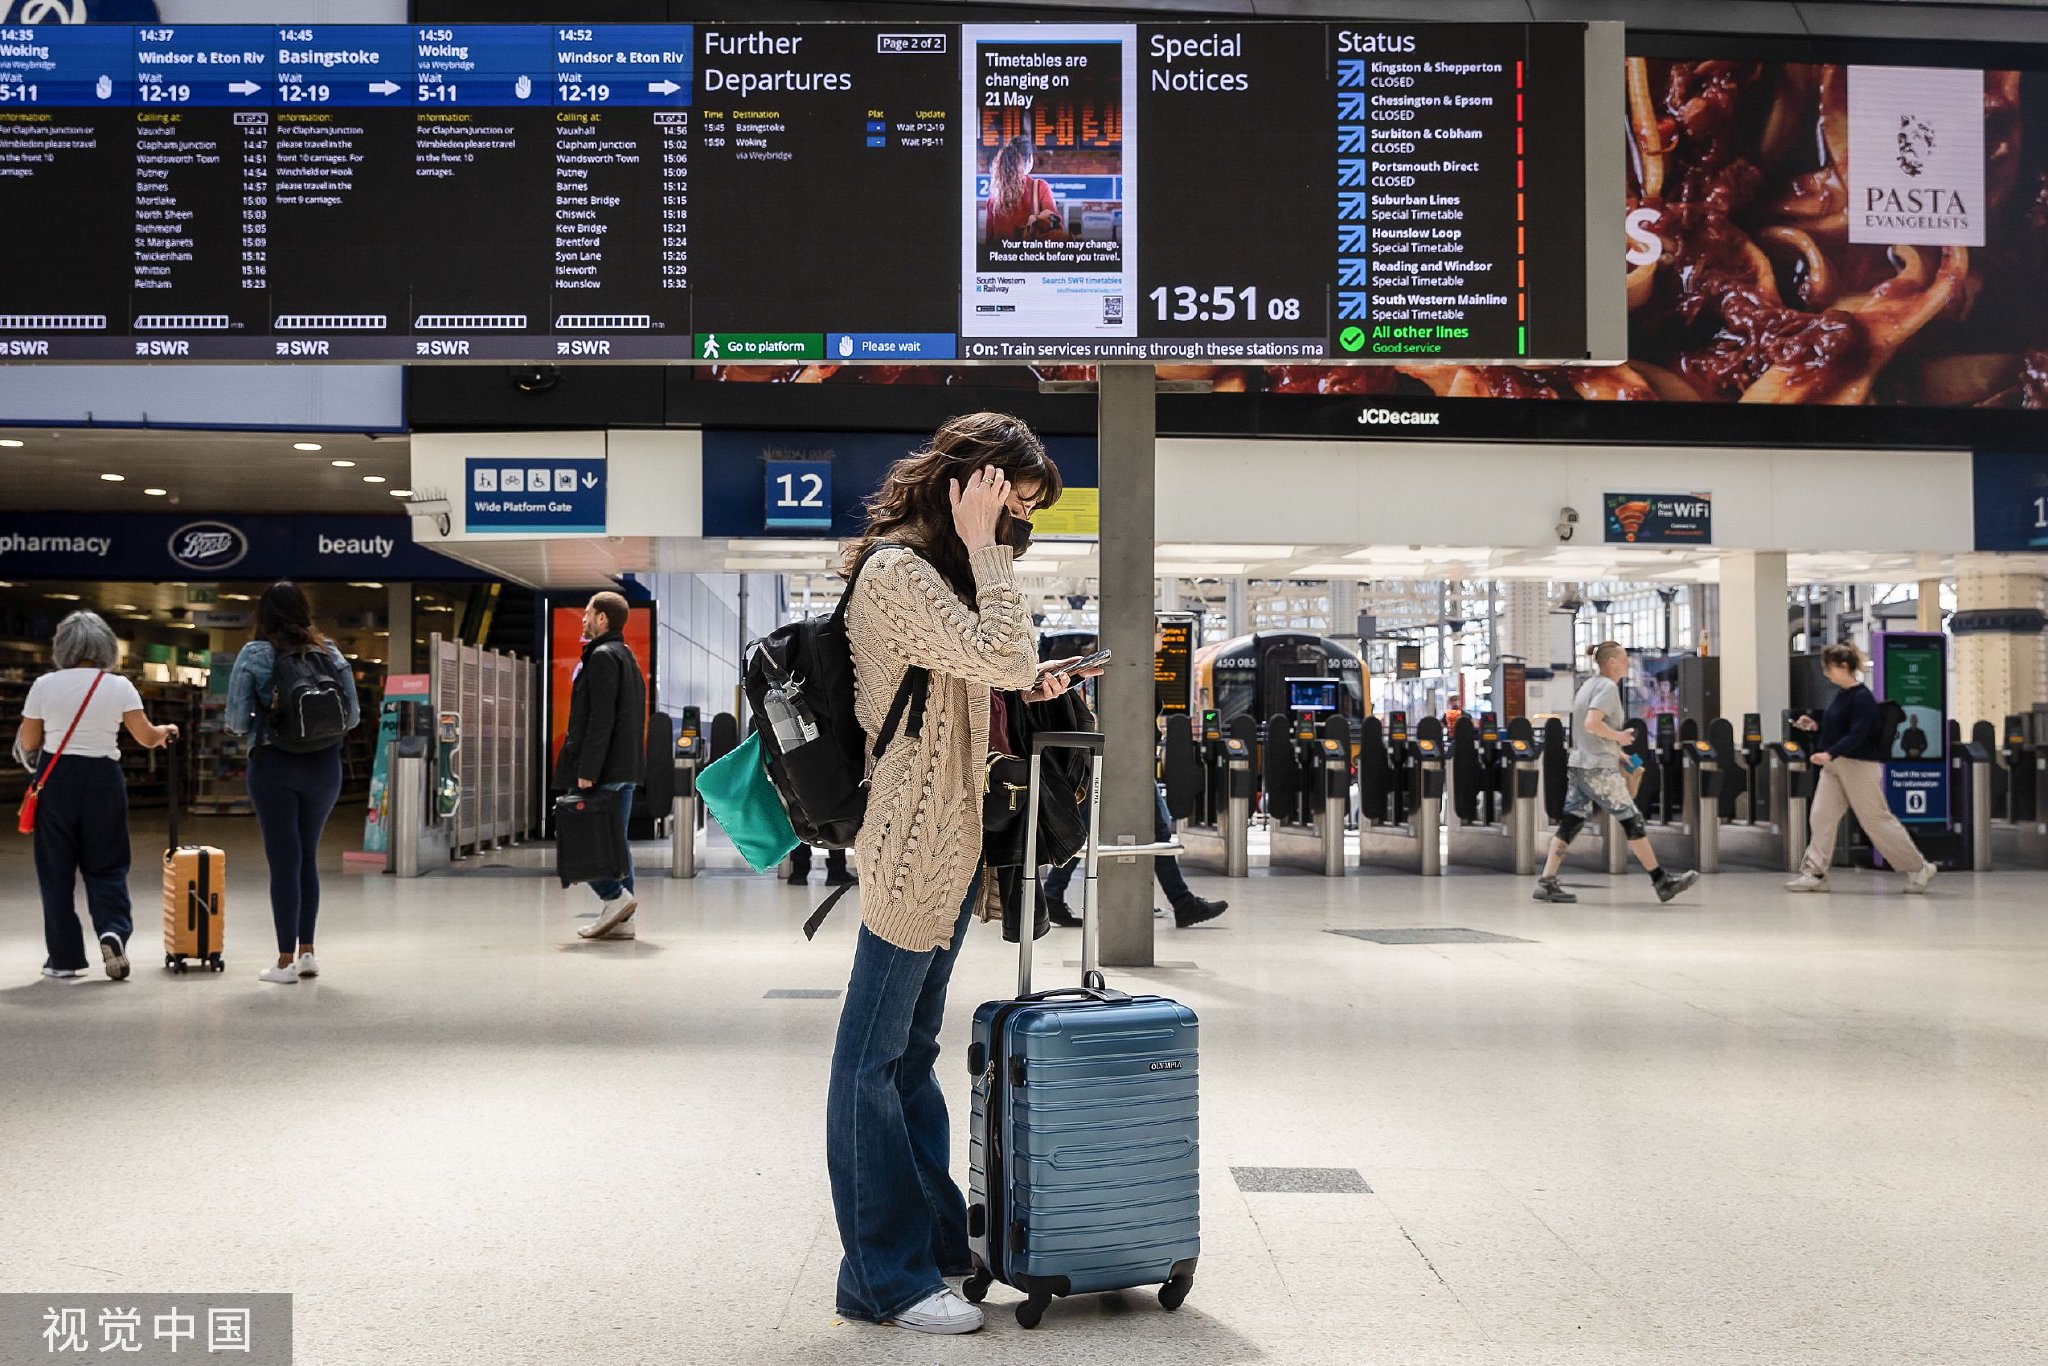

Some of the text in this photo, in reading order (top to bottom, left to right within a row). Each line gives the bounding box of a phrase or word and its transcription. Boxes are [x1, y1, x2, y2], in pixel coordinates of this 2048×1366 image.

[0, 29, 34, 41] 14:35
[139, 30, 175, 41] 14:37
[278, 30, 314, 41] 14:45
[418, 30, 453, 41] 14:50
[558, 29, 593, 41] 14:52
[705, 31, 803, 54] Further
[883, 38, 941, 50] Page 2 of 2
[1338, 31, 1416, 52] Status
[0, 44, 50, 59] Woking
[417, 44, 469, 60] Woking
[1150, 33, 1241, 63] Special
[138, 52, 195, 63] Windsor
[196, 52, 208, 63] &
[210, 52, 241, 63] Eton
[278, 49, 380, 67] Basingstoke
[556, 51, 614, 64] Windsor
[615, 52, 628, 63] &
[629, 52, 660, 63] Eton
[984, 53, 1088, 67] Timetables are
[1371, 62, 1503, 75] Kingston & Shepperton
[137, 73, 163, 83] Wait
[277, 73, 303, 83] Wait
[417, 72, 443, 83] Wait
[557, 72, 583, 82] Wait
[705, 69, 852, 97] Departures
[985, 73, 1069, 90] changing on
[1151, 69, 1249, 91] Notices
[1370, 77, 1415, 87] CLOSED
[0, 84, 38, 101] 5-11
[138, 85, 191, 101] 12-19
[278, 85, 330, 101] 12-19
[418, 85, 457, 101] 5-11
[558, 85, 610, 101] 12-19
[985, 92, 1034, 109] 21 May
[1370, 95, 1493, 108] Chessington & Epsom
[867, 110, 884, 118] Plat
[915, 111, 946, 120] Update
[1370, 110, 1415, 120] CLOSED
[735, 124, 785, 133] Basingstoke
[1371, 128, 1483, 138] Surbiton & Cobham
[735, 138, 767, 148] Woking
[1371, 143, 1416, 153] CLOSED
[1371, 161, 1480, 171] Portsmouth Direct
[1371, 176, 1416, 186] CLOSED
[1371, 194, 1461, 205] Suburban Lines
[1866, 188, 1967, 214] PASTA
[1371, 209, 1464, 221] Special Timetable
[1865, 214, 1970, 229] EVANGELISTS
[1372, 228, 1462, 240] Hounslow Loop
[555, 237, 600, 246] Brentford
[662, 238, 688, 246] 15:24
[1001, 240, 1120, 251] Your train time may change.
[1371, 243, 1464, 255] Special Timetable
[555, 252, 602, 262] Syon Lane
[662, 252, 688, 260] 15:26
[989, 252, 1121, 263] Please check before you travel.
[555, 266, 598, 274] Isleworth
[662, 266, 687, 274] 15:29
[1372, 261, 1493, 274] Reading and Windsor
[555, 279, 601, 288] Hounslow
[662, 279, 687, 288] 15:32
[1371, 276, 1465, 288] Special Timetable
[982, 285, 1010, 294] Railway
[1148, 286, 1300, 321] 13:51 08
[1371, 294, 1508, 305] South Western Mainline
[1371, 309, 1465, 321] Special Timetable
[1372, 326, 1469, 338] All other lines
[9, 341, 49, 355] SWR
[149, 341, 190, 355] SWR
[289, 341, 330, 355] SWR
[430, 341, 470, 355] SWR
[570, 341, 611, 355] SWR
[727, 341, 805, 353] Go to platform
[861, 341, 921, 352] Please wait
[972, 343, 999, 355] On:
[1000, 343, 1036, 355] Train
[1037, 343, 1092, 355] services
[1094, 343, 1148, 358] running
[1149, 343, 1204, 358] through
[1206, 343, 1244, 355] these
[1246, 342, 1300, 355] stations
[1301, 345, 1324, 355] ma
[1372, 342, 1403, 352] Good
[1357, 409, 1440, 424] JCDecaux
[776, 474, 823, 508] 12
[474, 502, 573, 511] Wide Platform Gate
[1673, 503, 1709, 517] WiFi
[0, 533, 112, 556] pharmacy
[318, 535, 394, 557] beauty
[1216, 658, 1236, 668] 450
